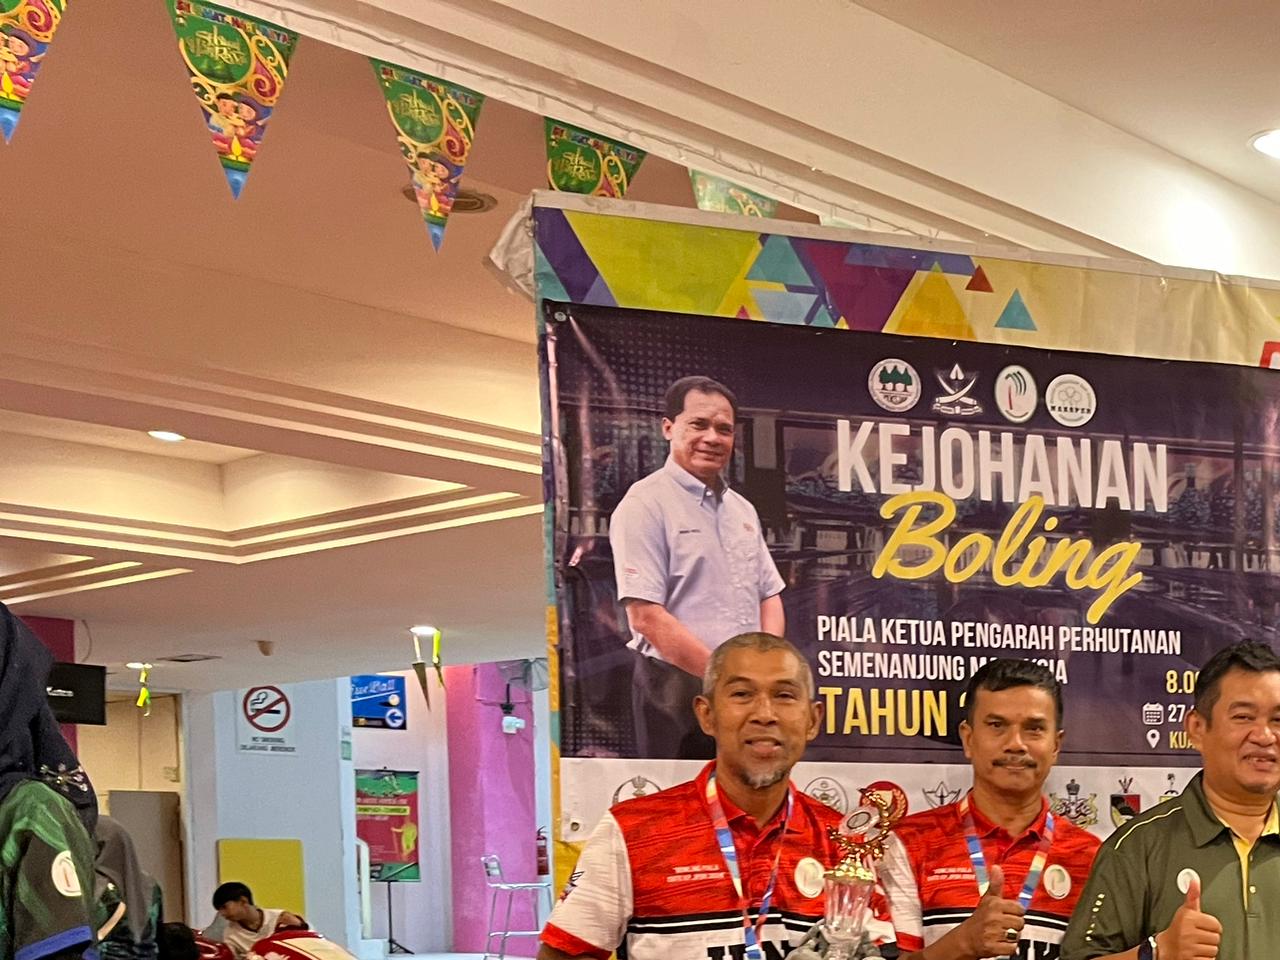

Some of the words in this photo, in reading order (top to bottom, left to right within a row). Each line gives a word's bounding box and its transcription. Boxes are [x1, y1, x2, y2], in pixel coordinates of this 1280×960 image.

[837, 419, 1168, 513] KEJOHANAN
[872, 491, 1143, 625] Boling
[817, 615, 877, 643] PIALA
[881, 618, 946, 646] KETUA
[951, 621, 1054, 651] PENGARAH
[1059, 626, 1181, 655] PERHUTANAN
[818, 650, 965, 681] SEMENANJUNG
[1166, 670, 1200, 694] 8.0
[818, 687, 947, 736] TAHUN
